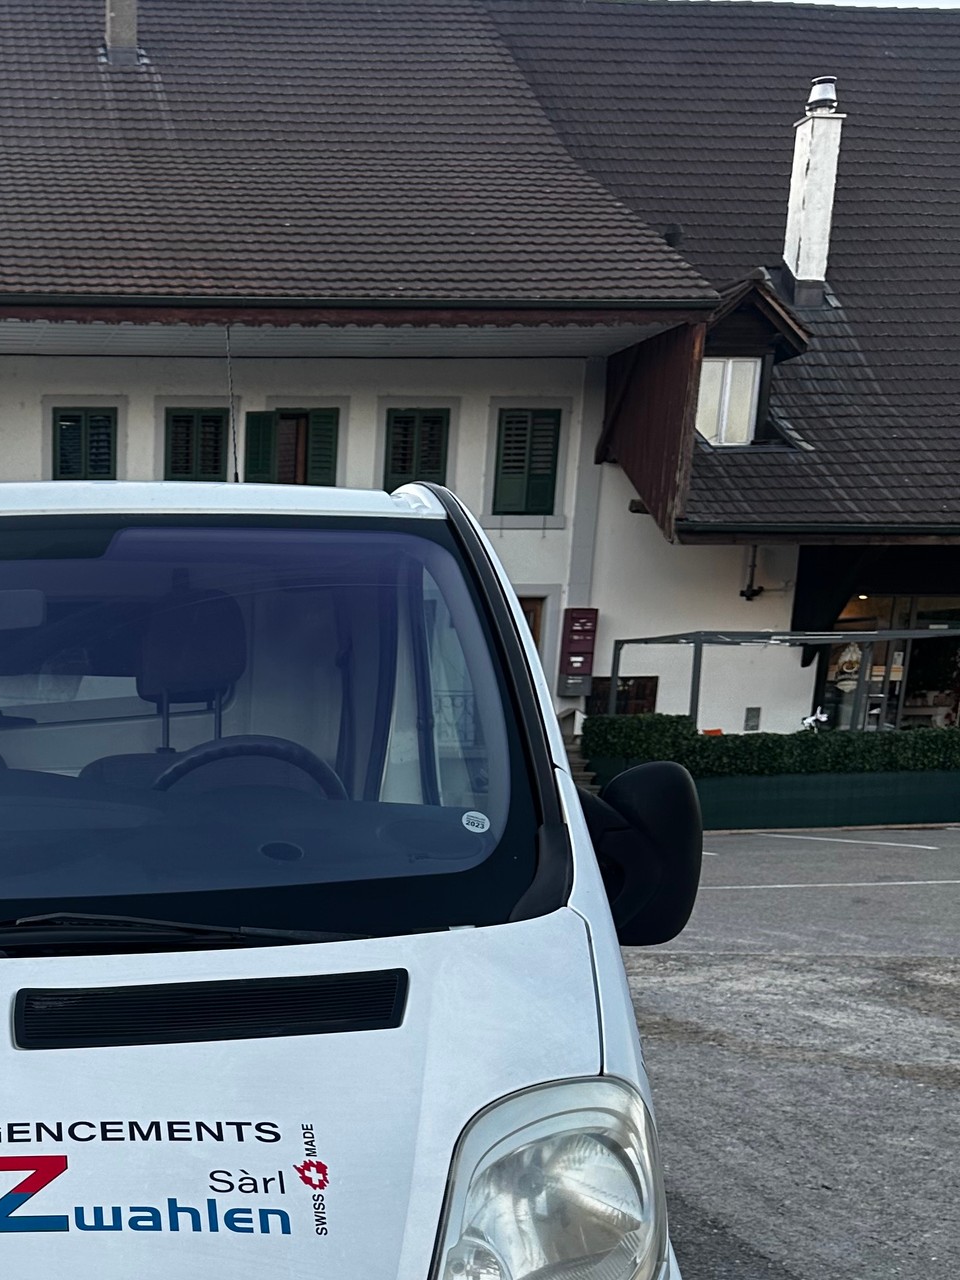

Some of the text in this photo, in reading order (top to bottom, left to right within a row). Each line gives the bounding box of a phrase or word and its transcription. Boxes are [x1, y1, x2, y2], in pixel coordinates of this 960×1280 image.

[465, 820, 485, 829] 2023
[208, 1169, 286, 1195] Sàrl
[301, 1123, 328, 1236] SWISS MADE
